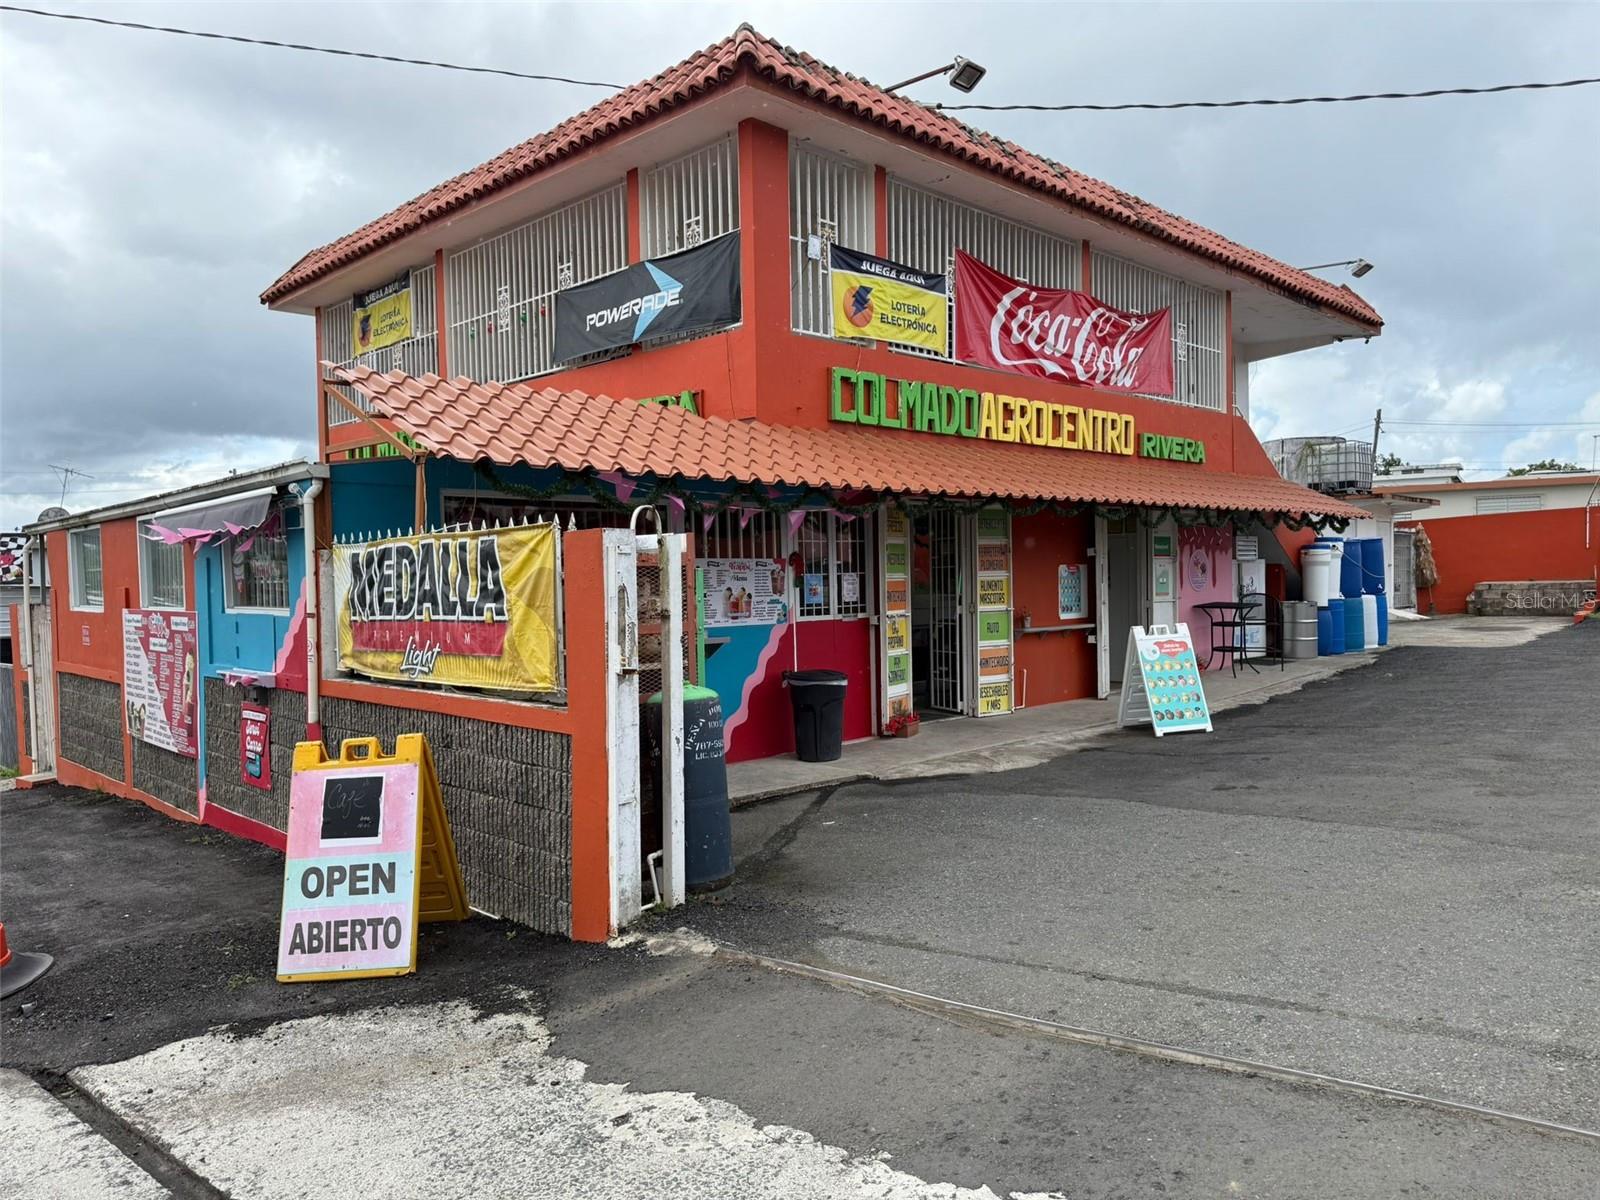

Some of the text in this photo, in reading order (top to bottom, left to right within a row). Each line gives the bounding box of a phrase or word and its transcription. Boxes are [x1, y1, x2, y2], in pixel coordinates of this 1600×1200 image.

[861, 260, 897, 279] JUEGA
[586, 286, 683, 332] POWERADE
[880, 313, 938, 336] ELECTRÓNICA
[990, 286, 1149, 388] Coca-Cola
[831, 367, 1206, 464] COLMADO AGROCENTRO RIVERA
[349, 535, 509, 622] MEDALLA
[980, 580, 1004, 592] ALIMENTO
[980, 593, 1005, 604] MASCOTAS
[373, 629, 471, 645] PREMIUM
[986, 622, 1000, 634] AUTO
[400, 635, 441, 679] Light
[300, 861, 396, 899] OPEN
[288, 916, 402, 956] ABIERTO
